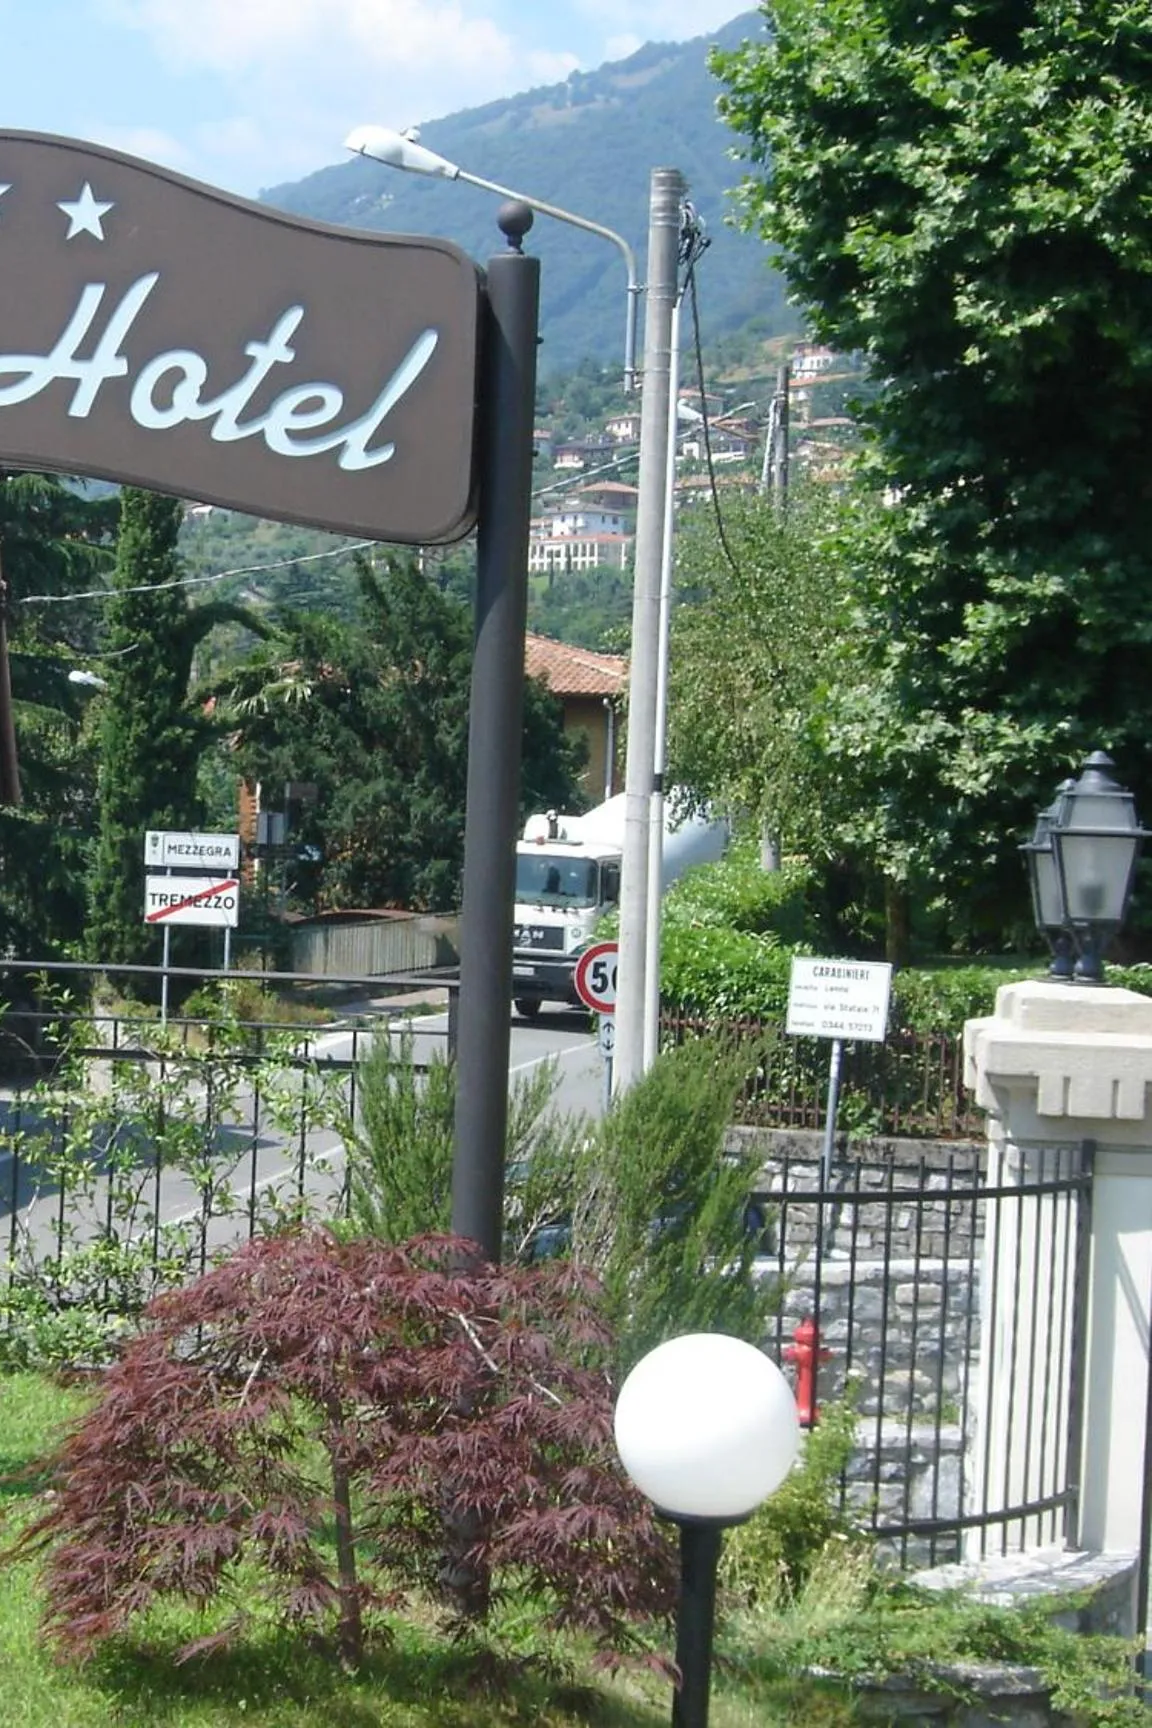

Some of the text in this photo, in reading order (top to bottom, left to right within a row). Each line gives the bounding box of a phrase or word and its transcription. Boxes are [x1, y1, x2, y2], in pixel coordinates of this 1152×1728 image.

[167, 844, 232, 857] MEZZEGRA
[149, 892, 236, 910] TREMEZZO
[812, 966, 870, 981] CARABINIERI
